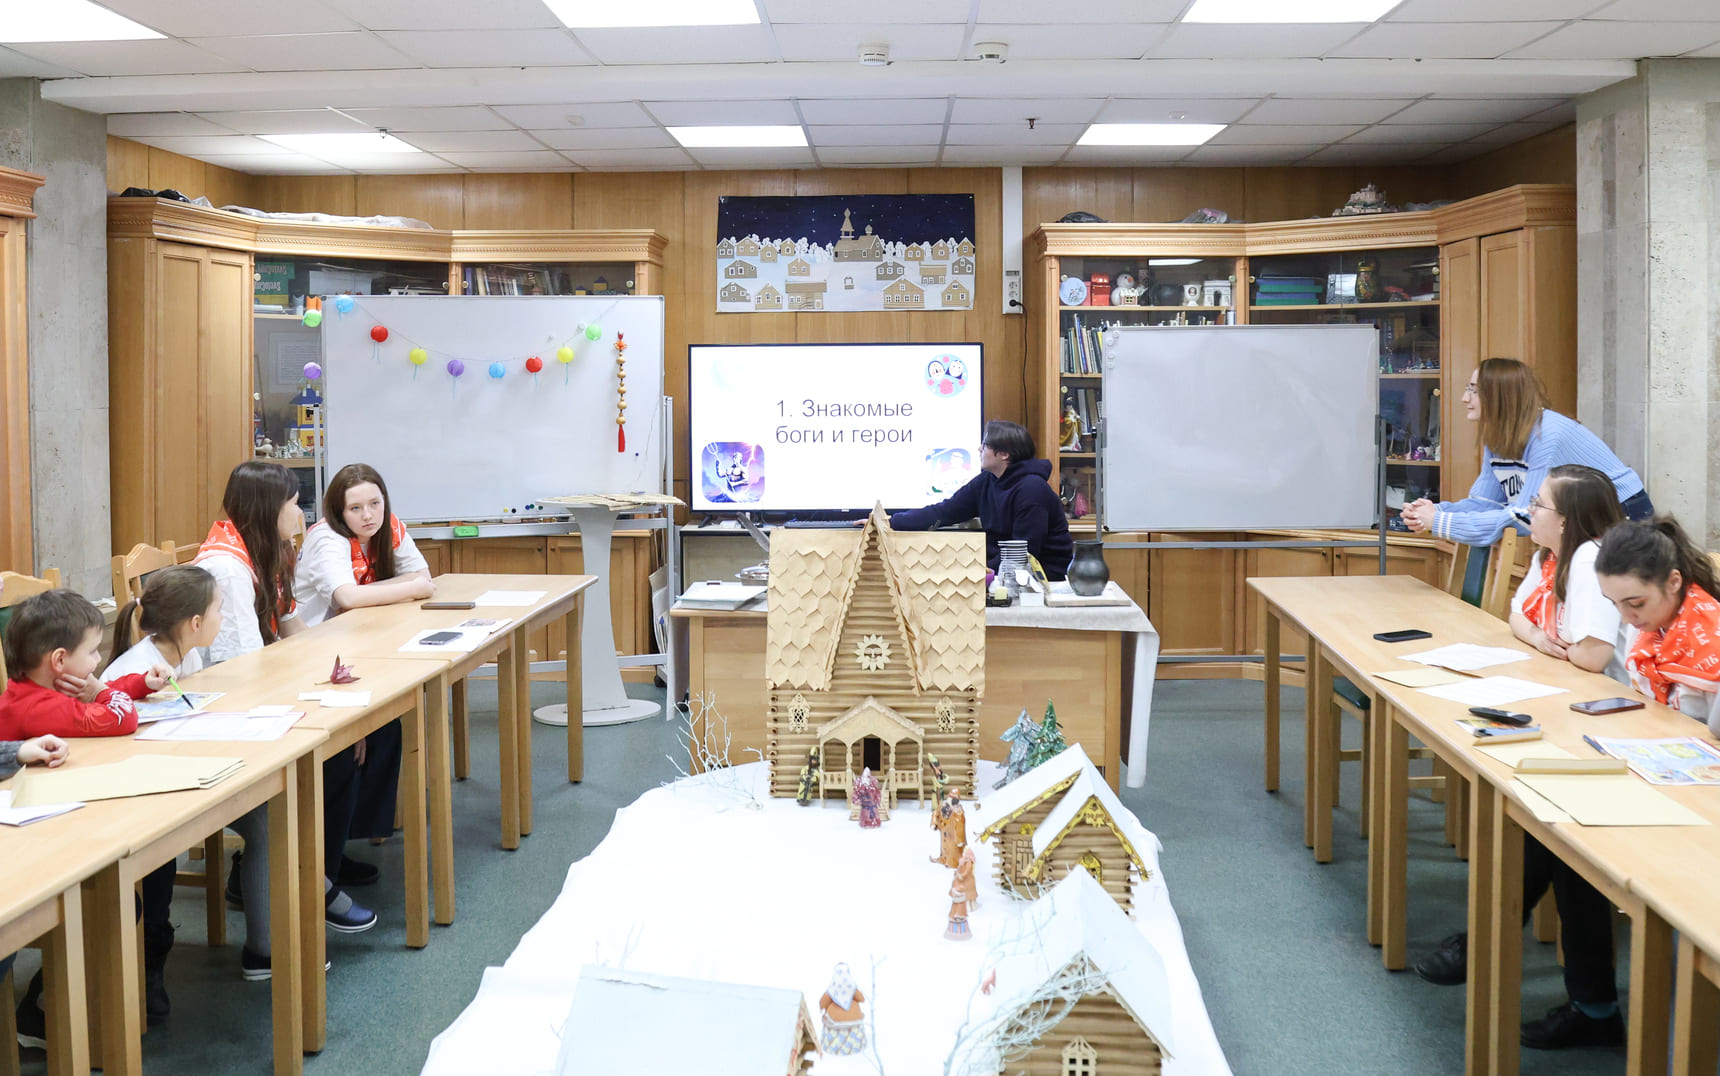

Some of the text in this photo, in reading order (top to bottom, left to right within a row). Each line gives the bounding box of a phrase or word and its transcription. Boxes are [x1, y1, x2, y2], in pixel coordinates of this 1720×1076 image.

[776, 399, 913, 417] 1. Знакомые
[775, 425, 913, 448] боги и герои
